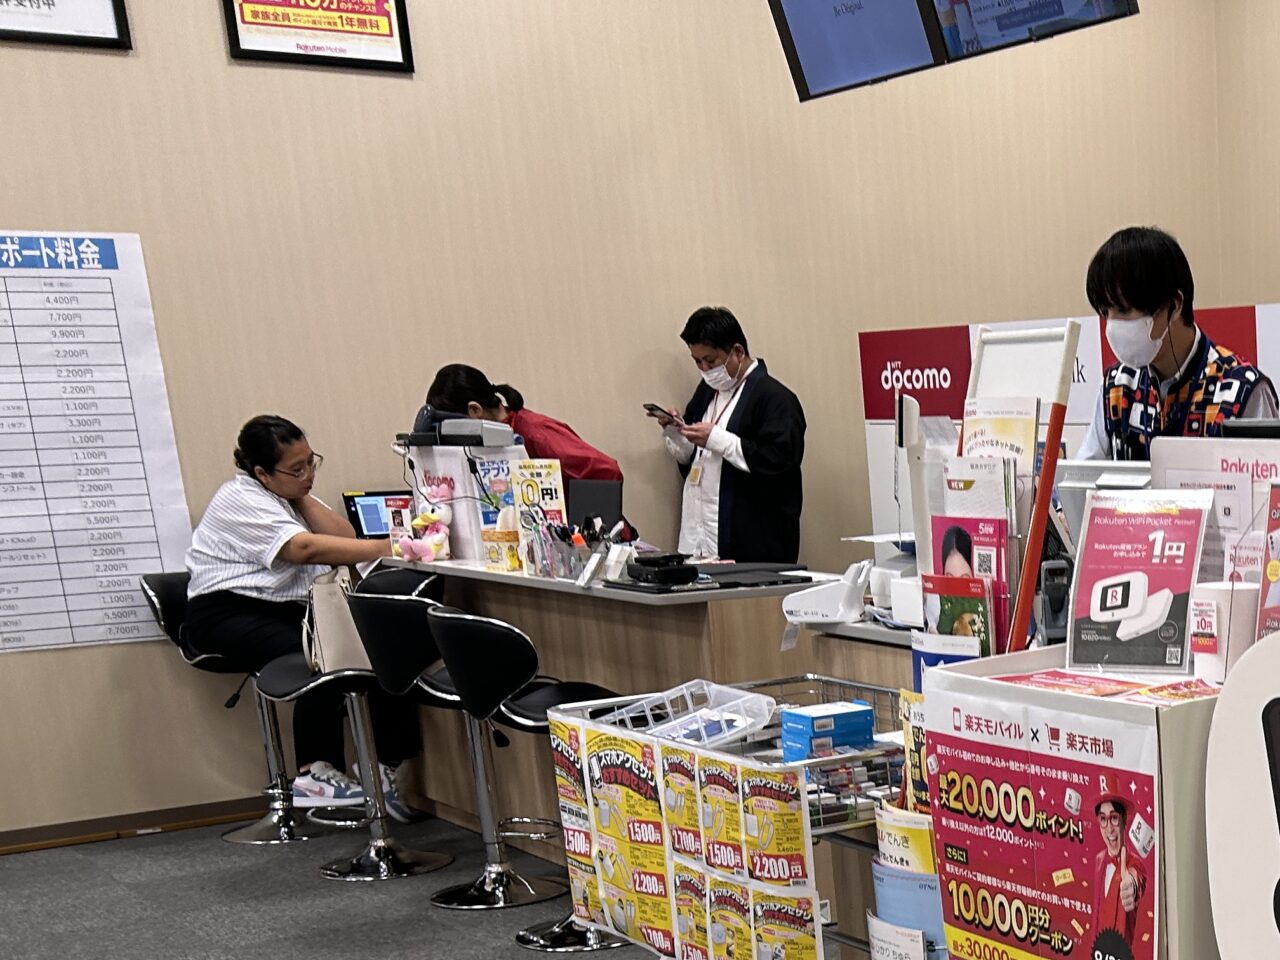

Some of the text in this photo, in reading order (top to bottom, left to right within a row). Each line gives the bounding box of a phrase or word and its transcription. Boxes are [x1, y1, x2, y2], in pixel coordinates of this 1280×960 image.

[338, 15, 380, 30] 1年無料
[881, 362, 951, 390] docomo
[481, 466, 510, 478] アプリ
[1221, 457, 1278, 479] Rakuten
[1095, 516, 1127, 525] Rakuten
[1128, 516, 1145, 525] WiFi
[1146, 516, 1172, 527] Pocket
[1148, 529, 1185, 564] 1円
[964, 714, 1024, 741] 楽天モバイル
[1066, 732, 1114, 758] 楽天市場
[947, 847, 966, 862] さらに!
[1029, 925, 1073, 952] クーポン
